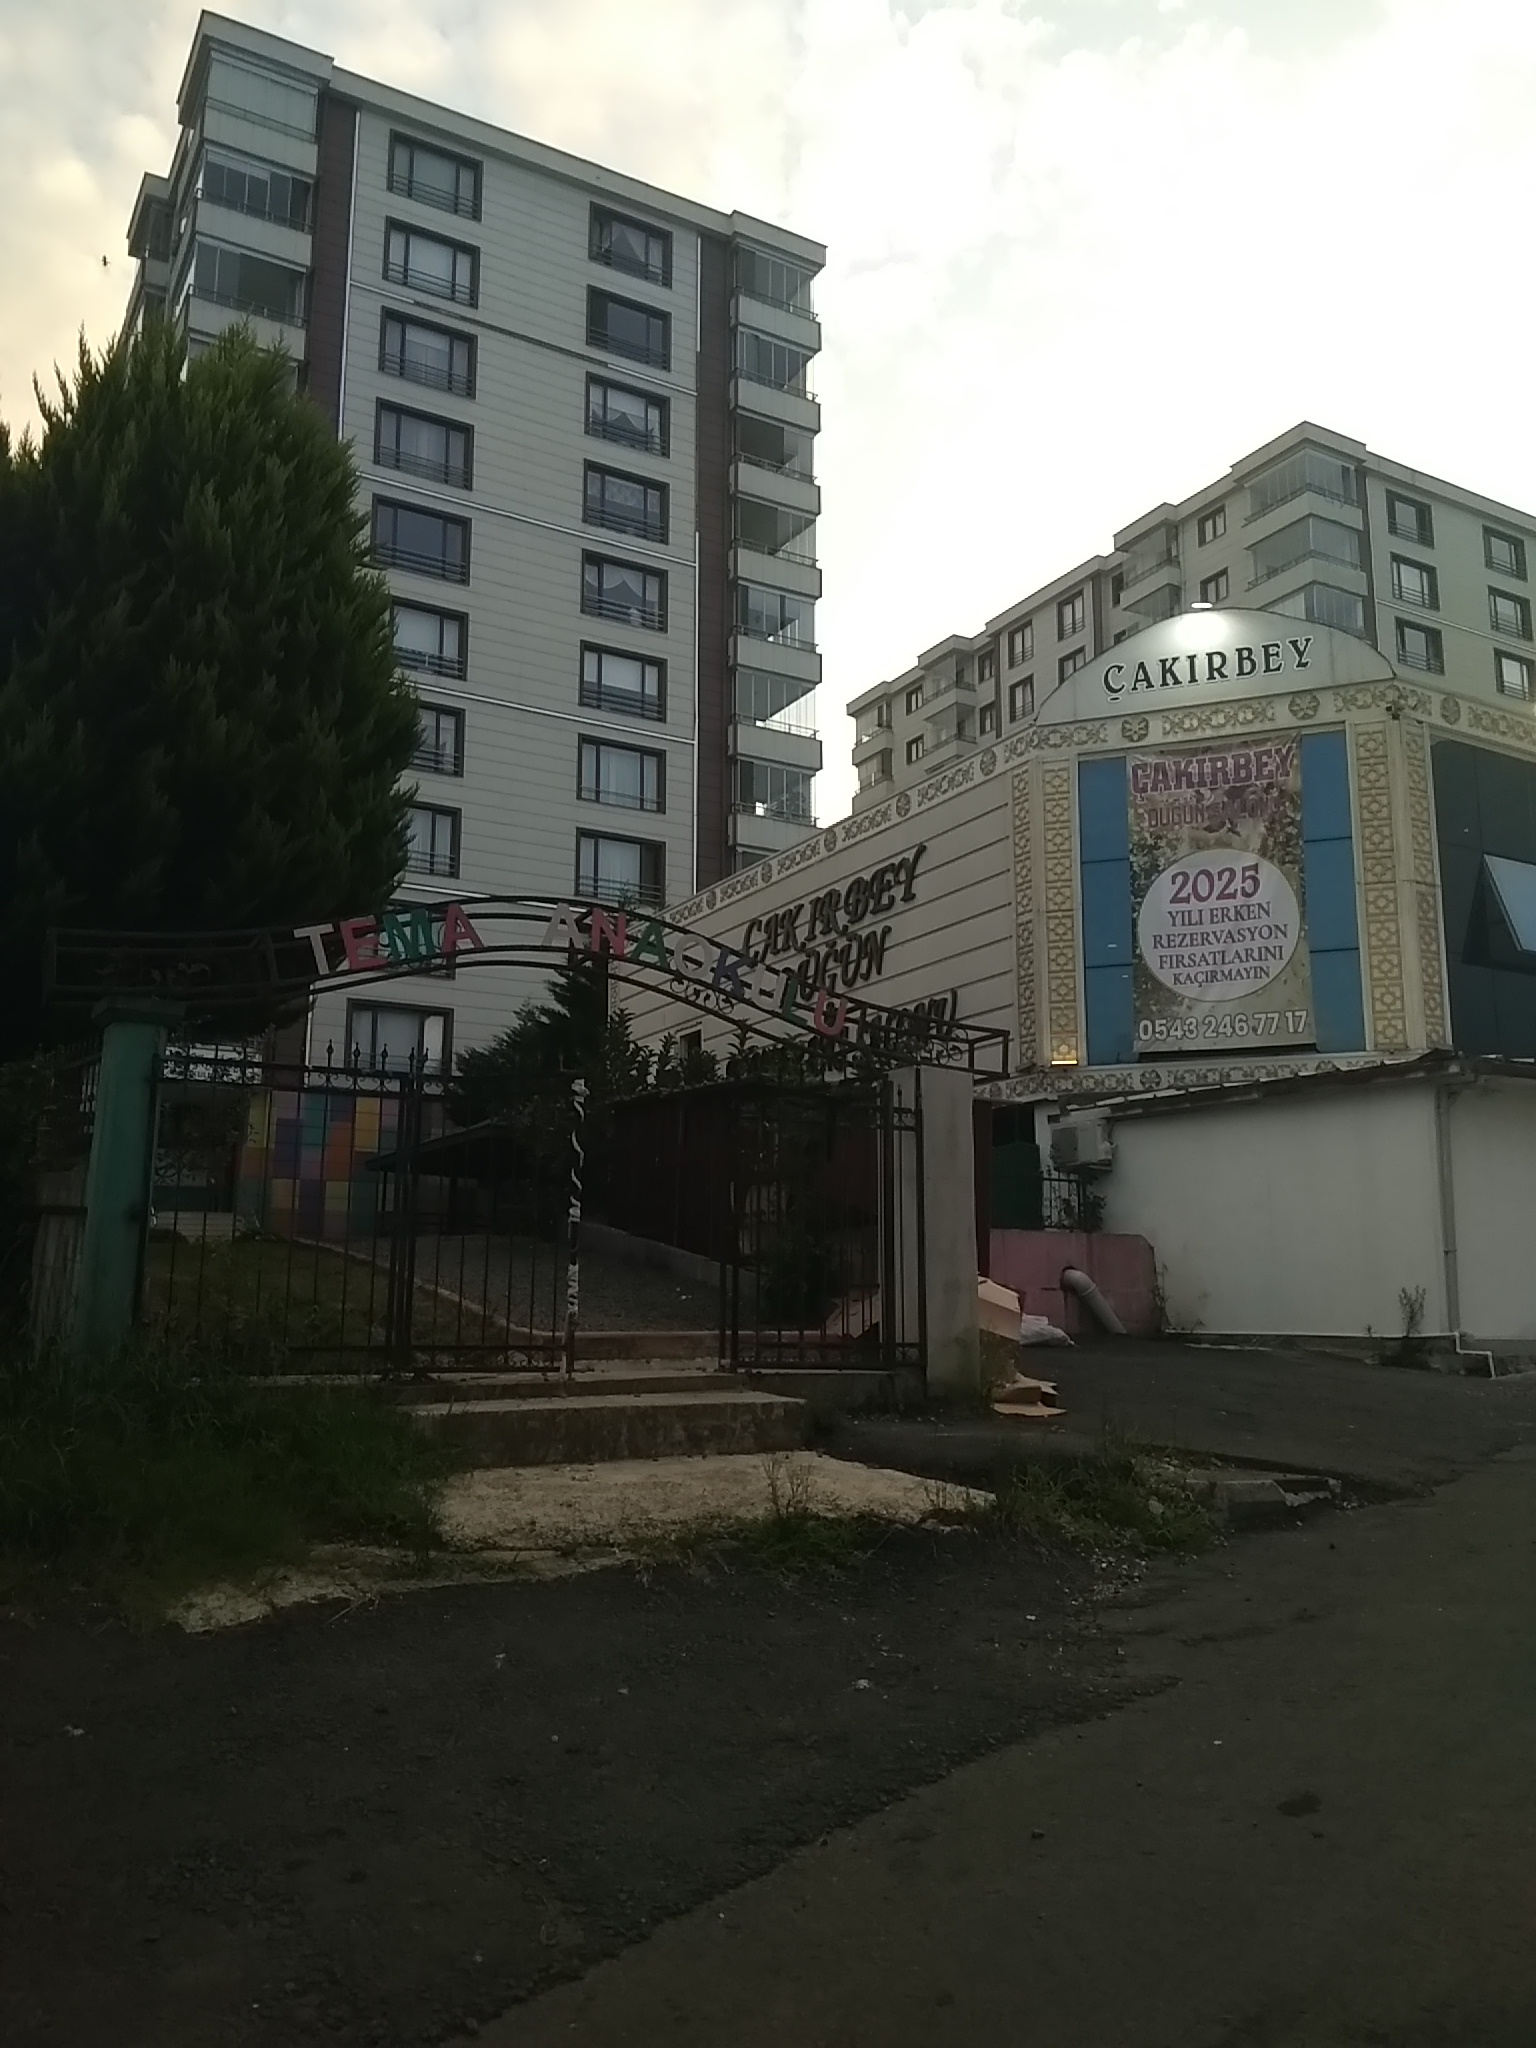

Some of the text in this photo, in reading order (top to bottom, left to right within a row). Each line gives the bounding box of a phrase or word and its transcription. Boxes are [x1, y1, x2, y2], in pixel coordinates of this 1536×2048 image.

[1103, 637, 1313, 701] ÇAKIRBEY
[1131, 745, 1294, 801] ÇAKIRBEY
[1169, 863, 1261, 904] 2025
[1167, 902, 1271, 927] YILI ERKEN
[1152, 924, 1288, 949] REZERVASYON
[293, 904, 484, 976] TEMA
[541, 902, 847, 1036] ANAOKULU
[1158, 945, 1284, 969] FIRSATLARINI
[1173, 966, 1270, 987] KAÇIRMAYIN
[1139, 1010, 1308, 1041] 0543 246 77 17
